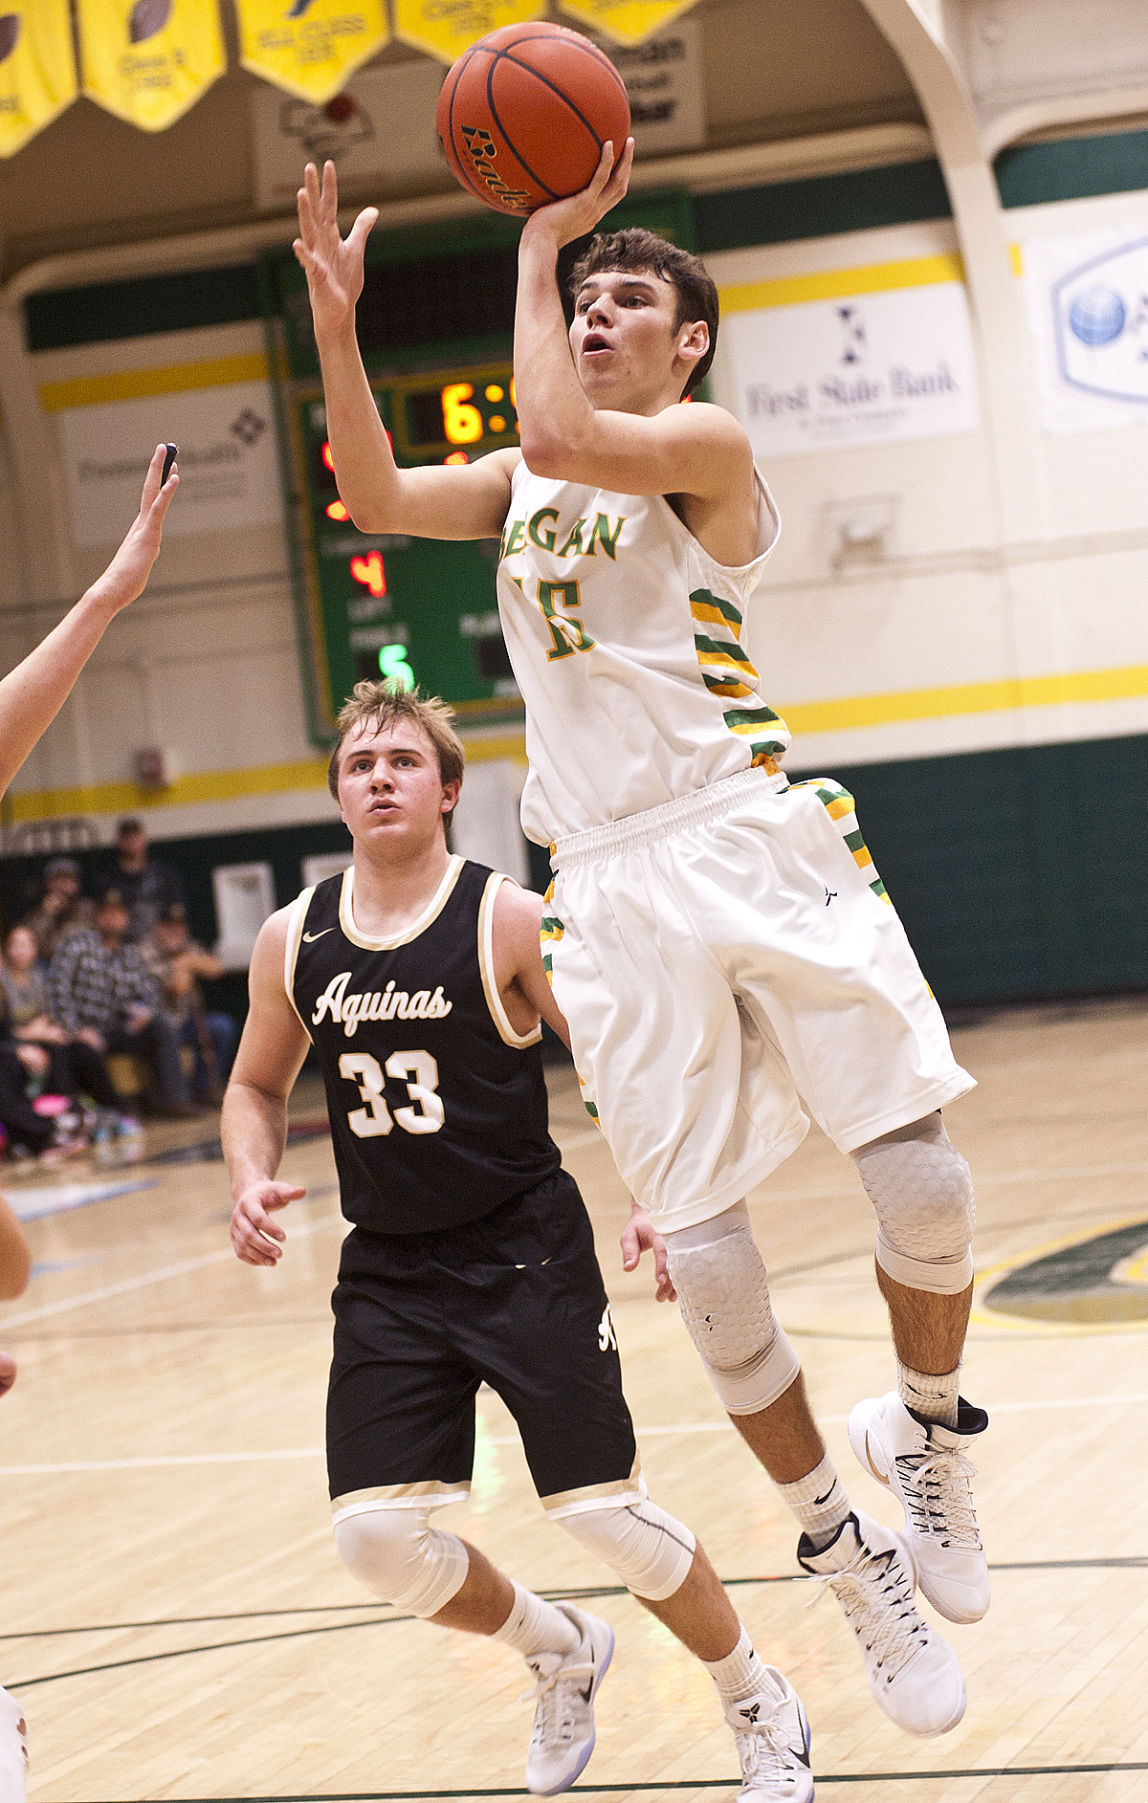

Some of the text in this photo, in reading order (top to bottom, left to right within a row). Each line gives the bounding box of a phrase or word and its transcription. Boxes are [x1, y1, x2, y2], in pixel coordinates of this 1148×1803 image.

[460, 124, 531, 210] Bade
[746, 359, 960, 418] First State Bank
[350, 550, 387, 599] 4
[378, 643, 415, 694] 5
[312, 972, 453, 1038] Aquinas
[338, 1049, 446, 1139] 33
